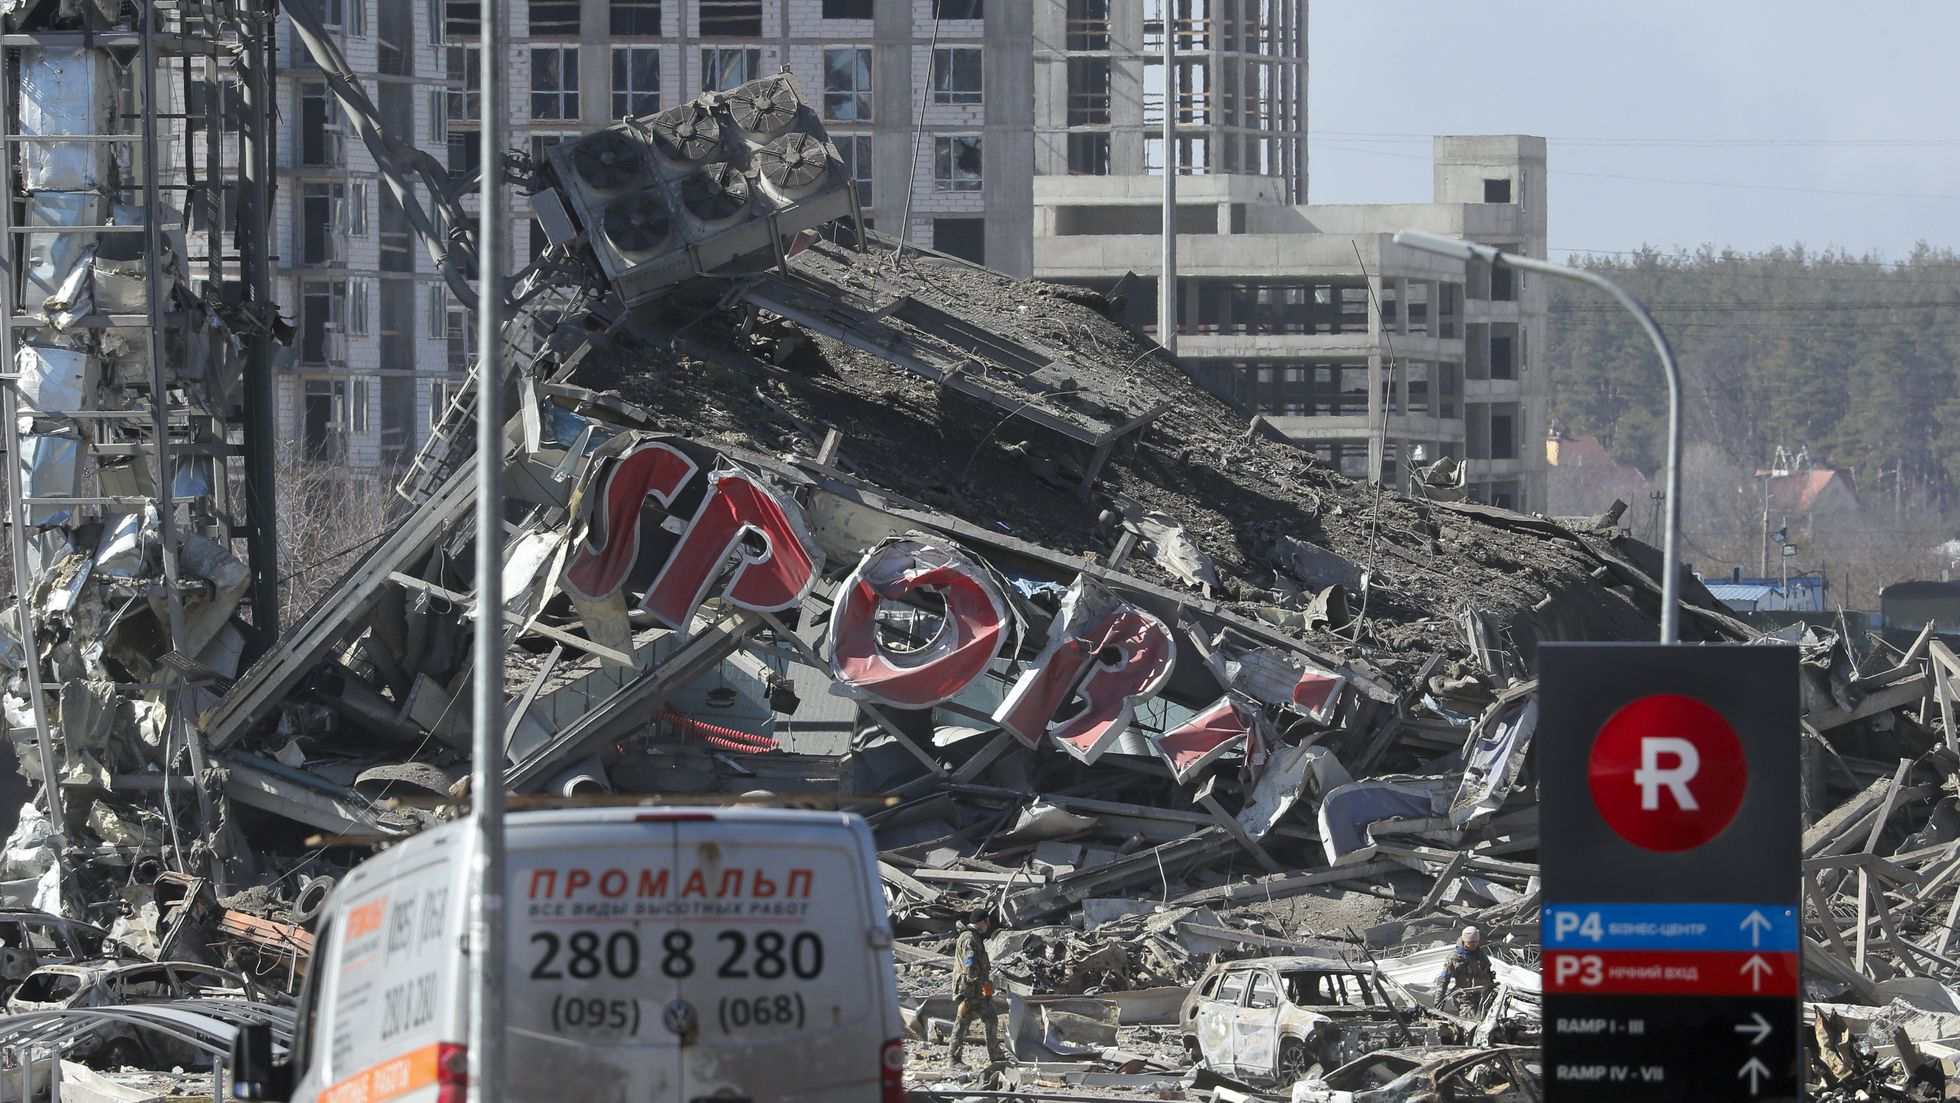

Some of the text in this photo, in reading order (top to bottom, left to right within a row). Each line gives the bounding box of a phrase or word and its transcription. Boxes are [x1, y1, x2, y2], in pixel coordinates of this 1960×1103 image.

[1634, 736, 1699, 810] R
[528, 868, 814, 898] ПРОМАЛЬП
[528, 901, 810, 917] ВСЕ ВИДЫ ВЫСОТНЫХ РАБОТ
[1555, 911, 1707, 942] P4 БІЗНЕС-ЦЕНТР
[530, 929, 824, 980] 280 8 280
[1555, 955, 1698, 986] P3 НІЧНИЙ ВХІД
[552, 991, 805, 1036] (095) (068)
[1556, 1018, 1607, 1034] RAMP
[1628, 1019, 1645, 1035] III
[1556, 1065, 1607, 1080] RAMP
[1610, 1066, 1628, 1081] IV
[1640, 1066, 1664, 1081] VII
